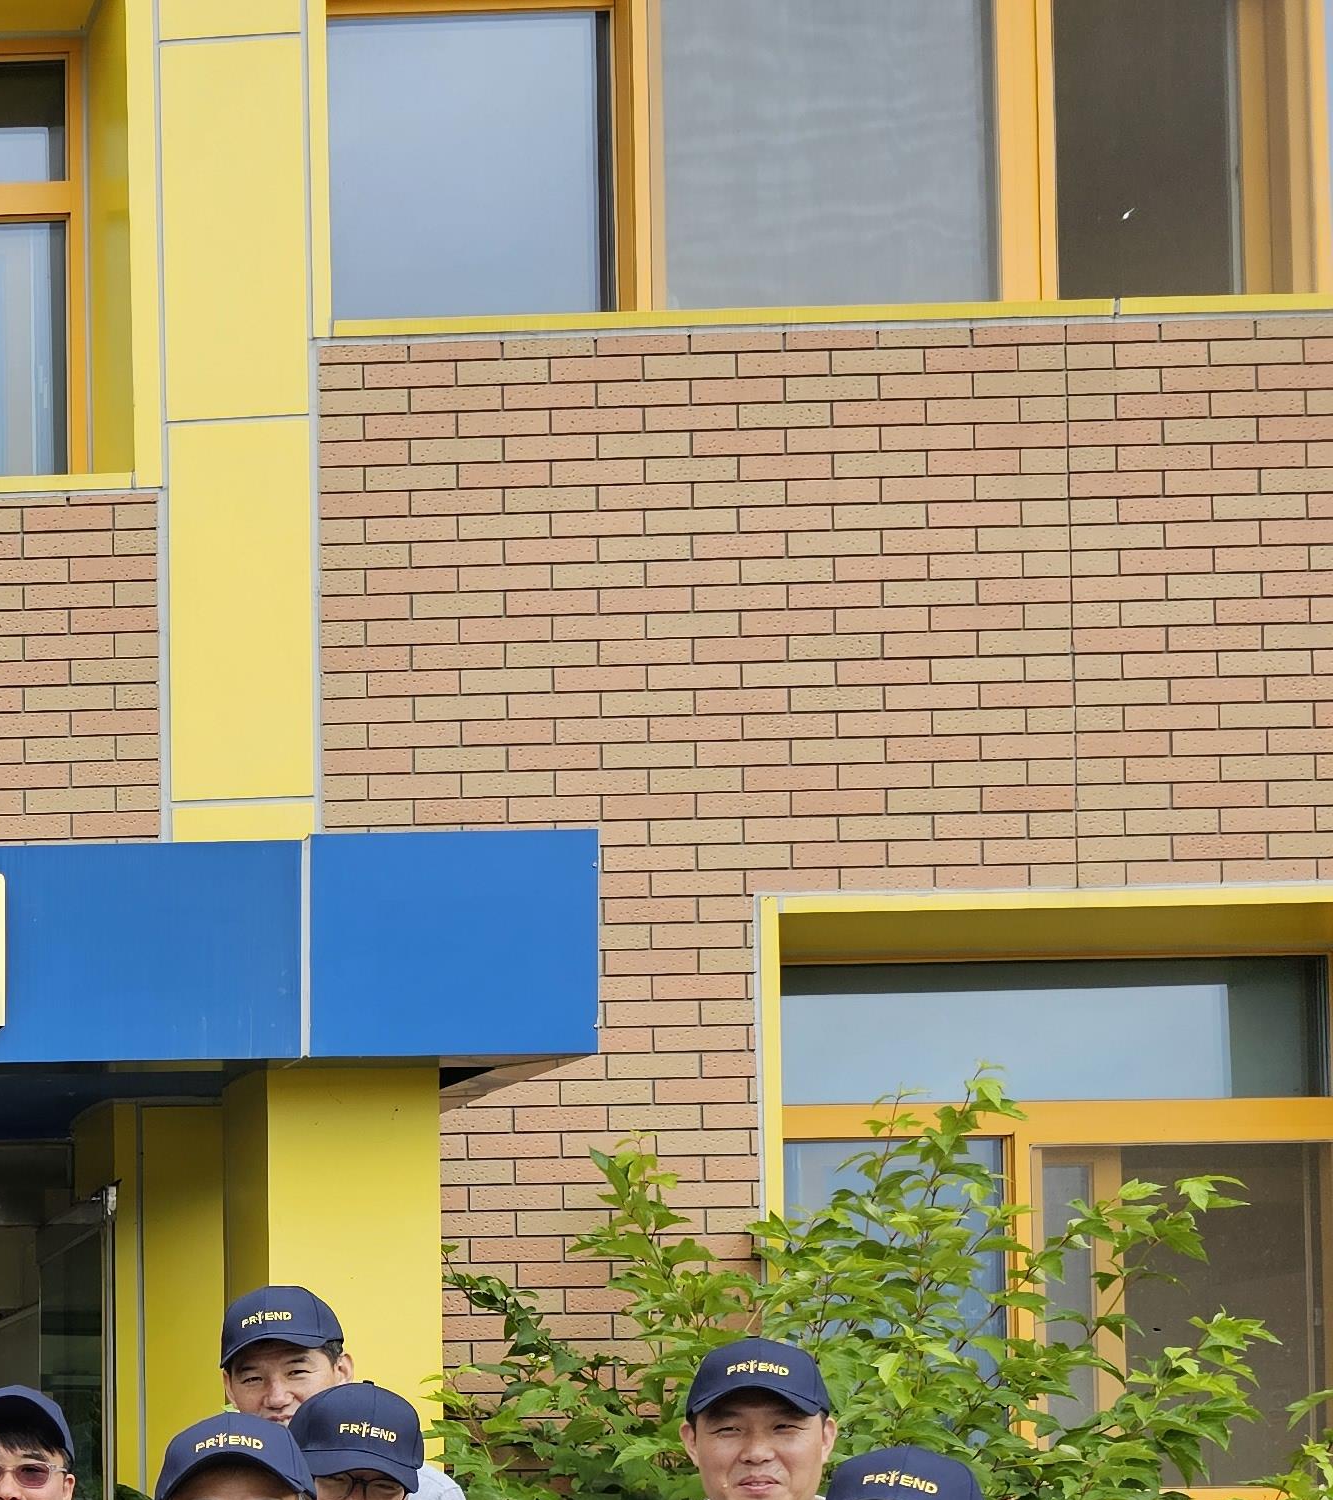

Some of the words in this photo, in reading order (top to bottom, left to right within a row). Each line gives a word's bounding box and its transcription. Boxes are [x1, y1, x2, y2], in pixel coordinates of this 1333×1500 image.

[241, 1310, 292, 1329] FRIEND
[726, 1359, 790, 1376] FRIEND
[195, 1432, 264, 1453] FRIEND
[339, 1421, 397, 1443] FRIEND
[862, 1470, 938, 1494] FRIEND
